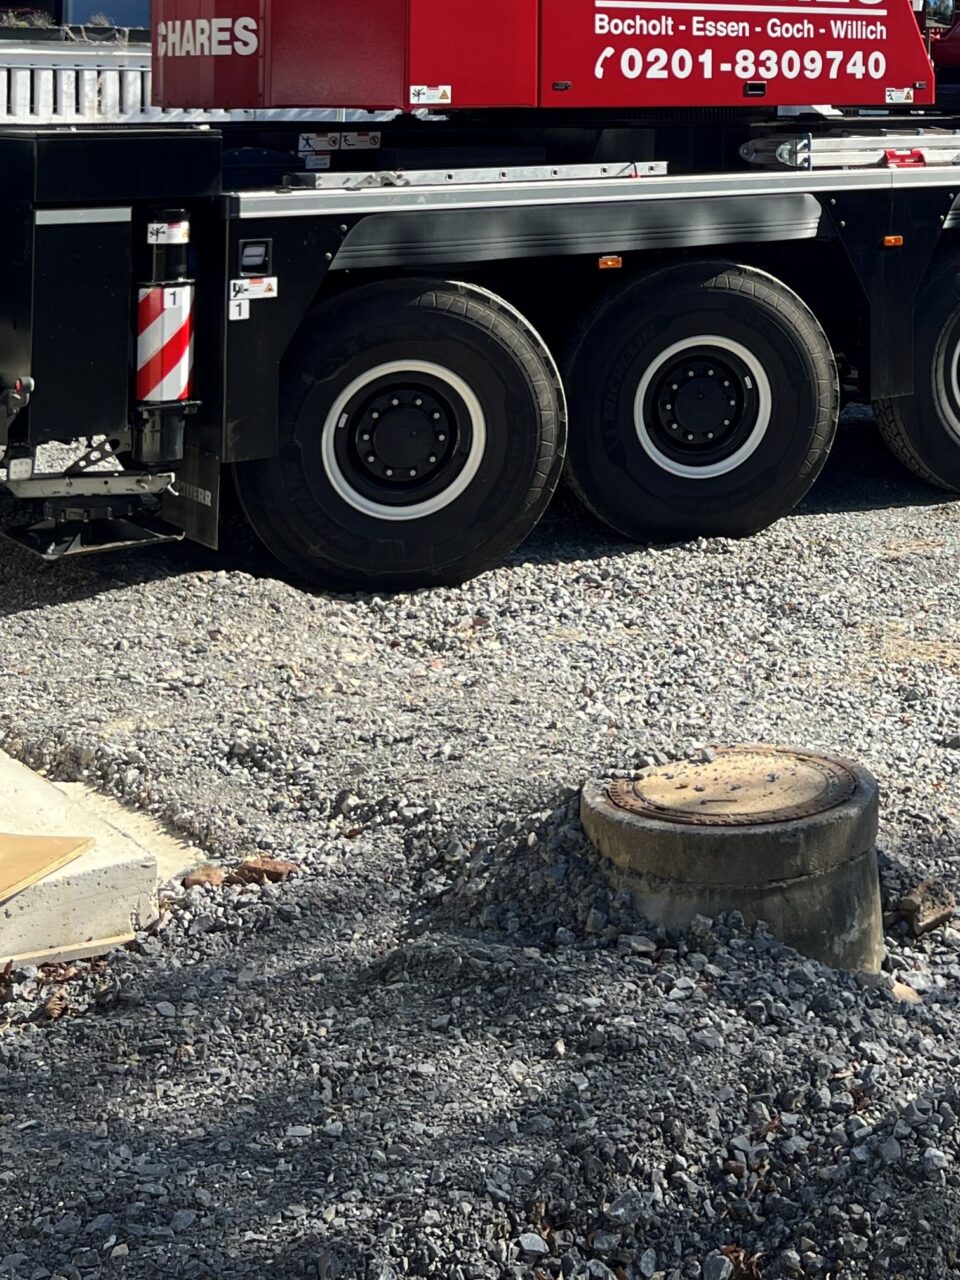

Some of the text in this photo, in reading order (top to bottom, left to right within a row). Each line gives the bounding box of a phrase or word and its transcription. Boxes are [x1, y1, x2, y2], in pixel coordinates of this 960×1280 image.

[157, 16, 258, 57] CHARES
[594, 13, 674, 36] Bocholt
[692, 16, 750, 37] Essen
[767, 18, 814, 39] Goch
[831, 20, 887, 40] Willich
[620, 48, 887, 80] 0201-8309740
[169, 291, 177, 306] 1
[235, 302, 242, 318] 1
